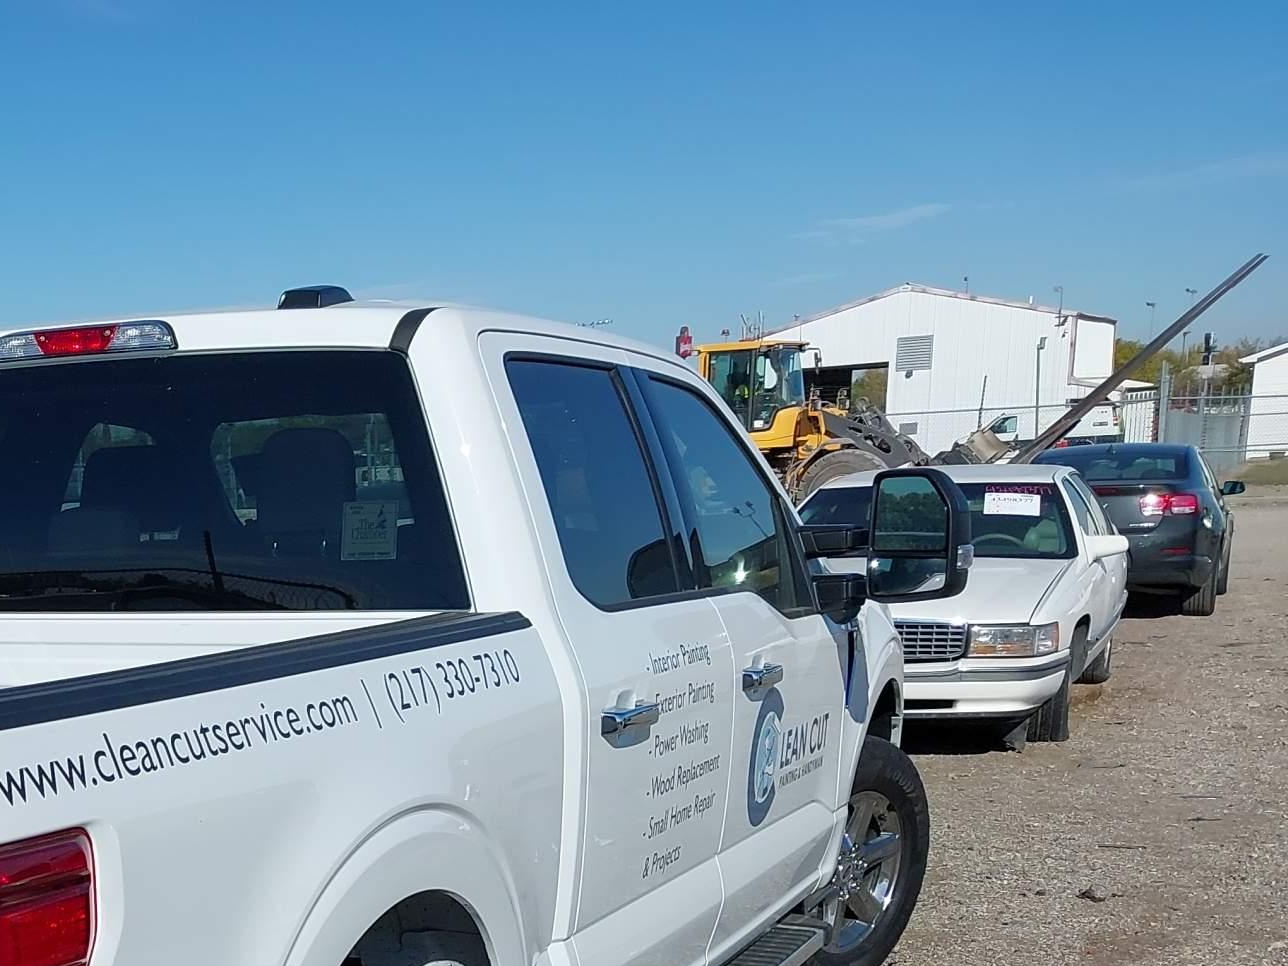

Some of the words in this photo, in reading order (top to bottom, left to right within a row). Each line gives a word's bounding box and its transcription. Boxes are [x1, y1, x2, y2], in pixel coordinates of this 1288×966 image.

[649, 649, 680, 675] Interior
[679, 642, 711, 666] Painting
[384, 665, 442, 724] (217)
[437, 648, 520, 700] 330-7310
[655, 688, 687, 715] Exterior
[688, 680, 715, 703] Painting
[654, 734, 679, 758] Power
[679, 720, 710, 745] Washing
[809, 712, 829, 755] CUT
[652, 767, 675, 799] Wood
[676, 755, 720, 792] Replacement
[648, 810, 669, 839] Small
[670, 804, 692, 829] Home
[693, 788, 716, 819] Repair
[643, 856, 650, 879] &
[650, 845, 681, 875] Projects
